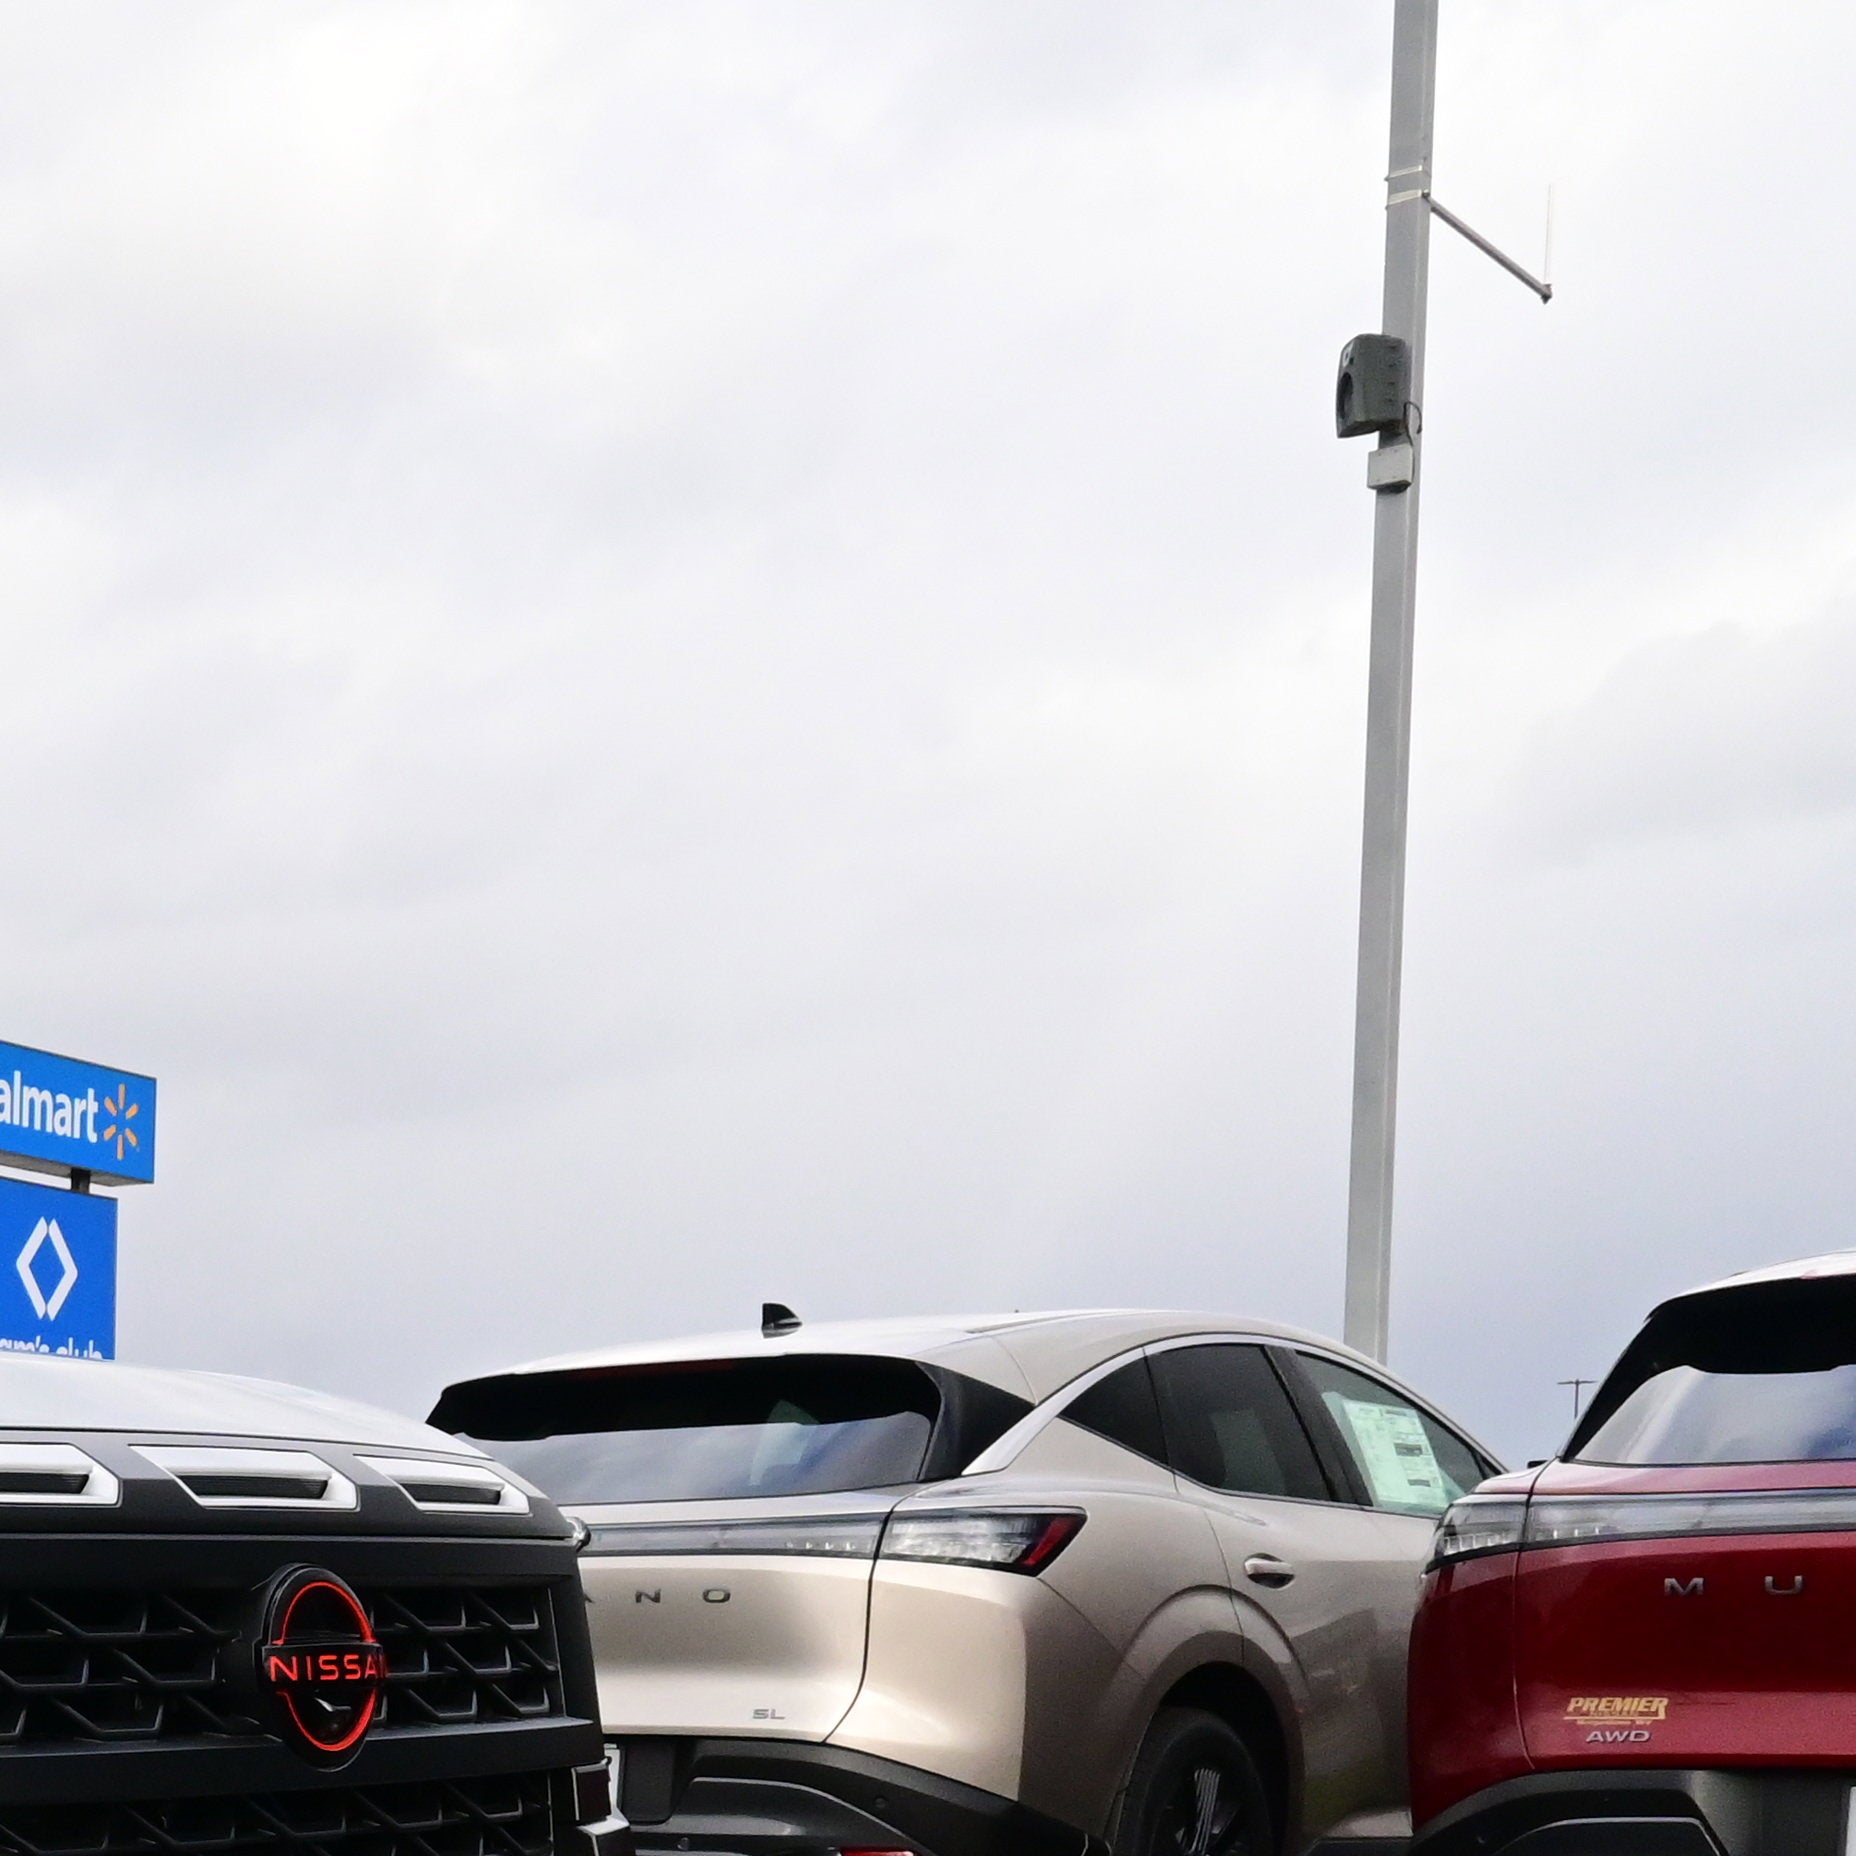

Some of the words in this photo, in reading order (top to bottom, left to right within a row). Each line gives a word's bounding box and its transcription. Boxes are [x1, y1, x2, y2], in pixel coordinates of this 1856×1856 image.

[584, 1588, 731, 1604] NO
[752, 1708, 786, 1720] SL
[1566, 1697, 1669, 1717] PREMIER
[1585, 1730, 1651, 1742] AWD
